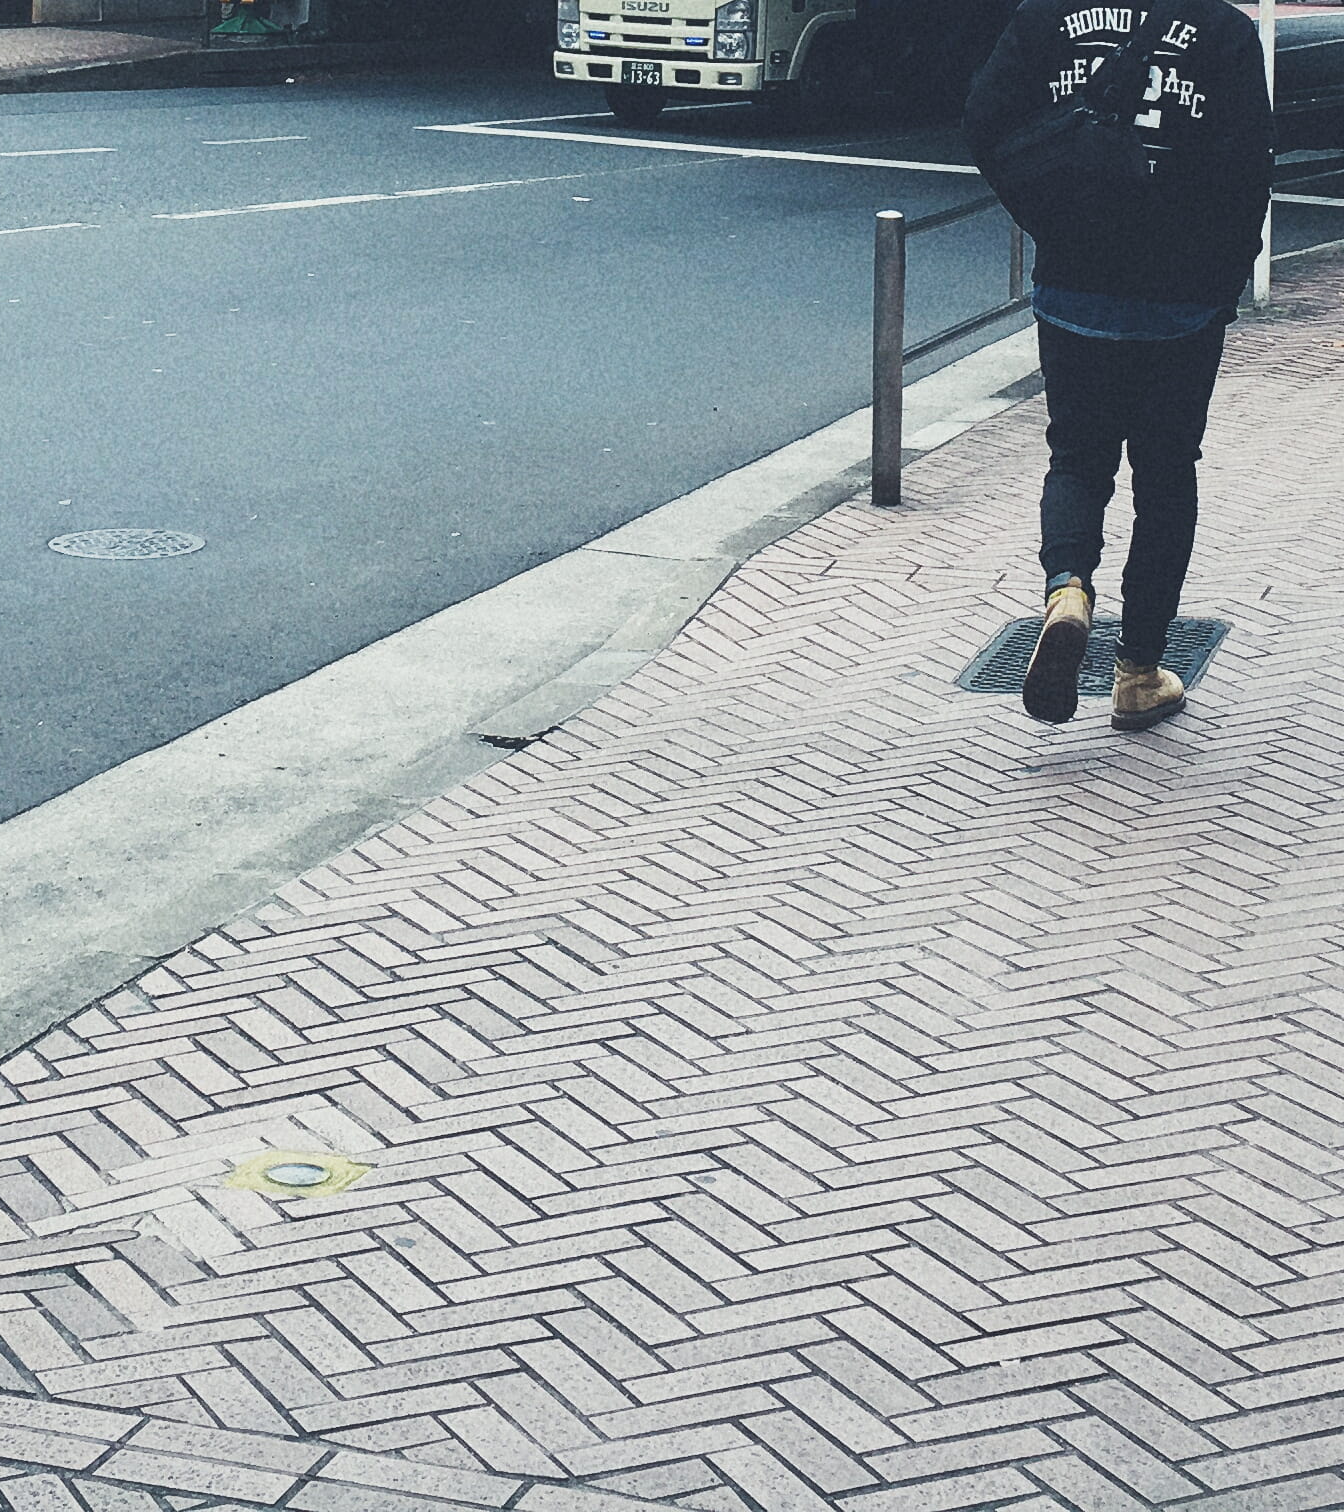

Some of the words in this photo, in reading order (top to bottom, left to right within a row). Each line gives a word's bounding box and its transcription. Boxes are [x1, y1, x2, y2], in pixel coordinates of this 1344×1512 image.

[621, 0, 670, 13] ISUZU
[1064, 7, 1132, 39] HOUND
[631, 70, 660, 86] 13-63
[1049, 58, 1088, 103] THE
